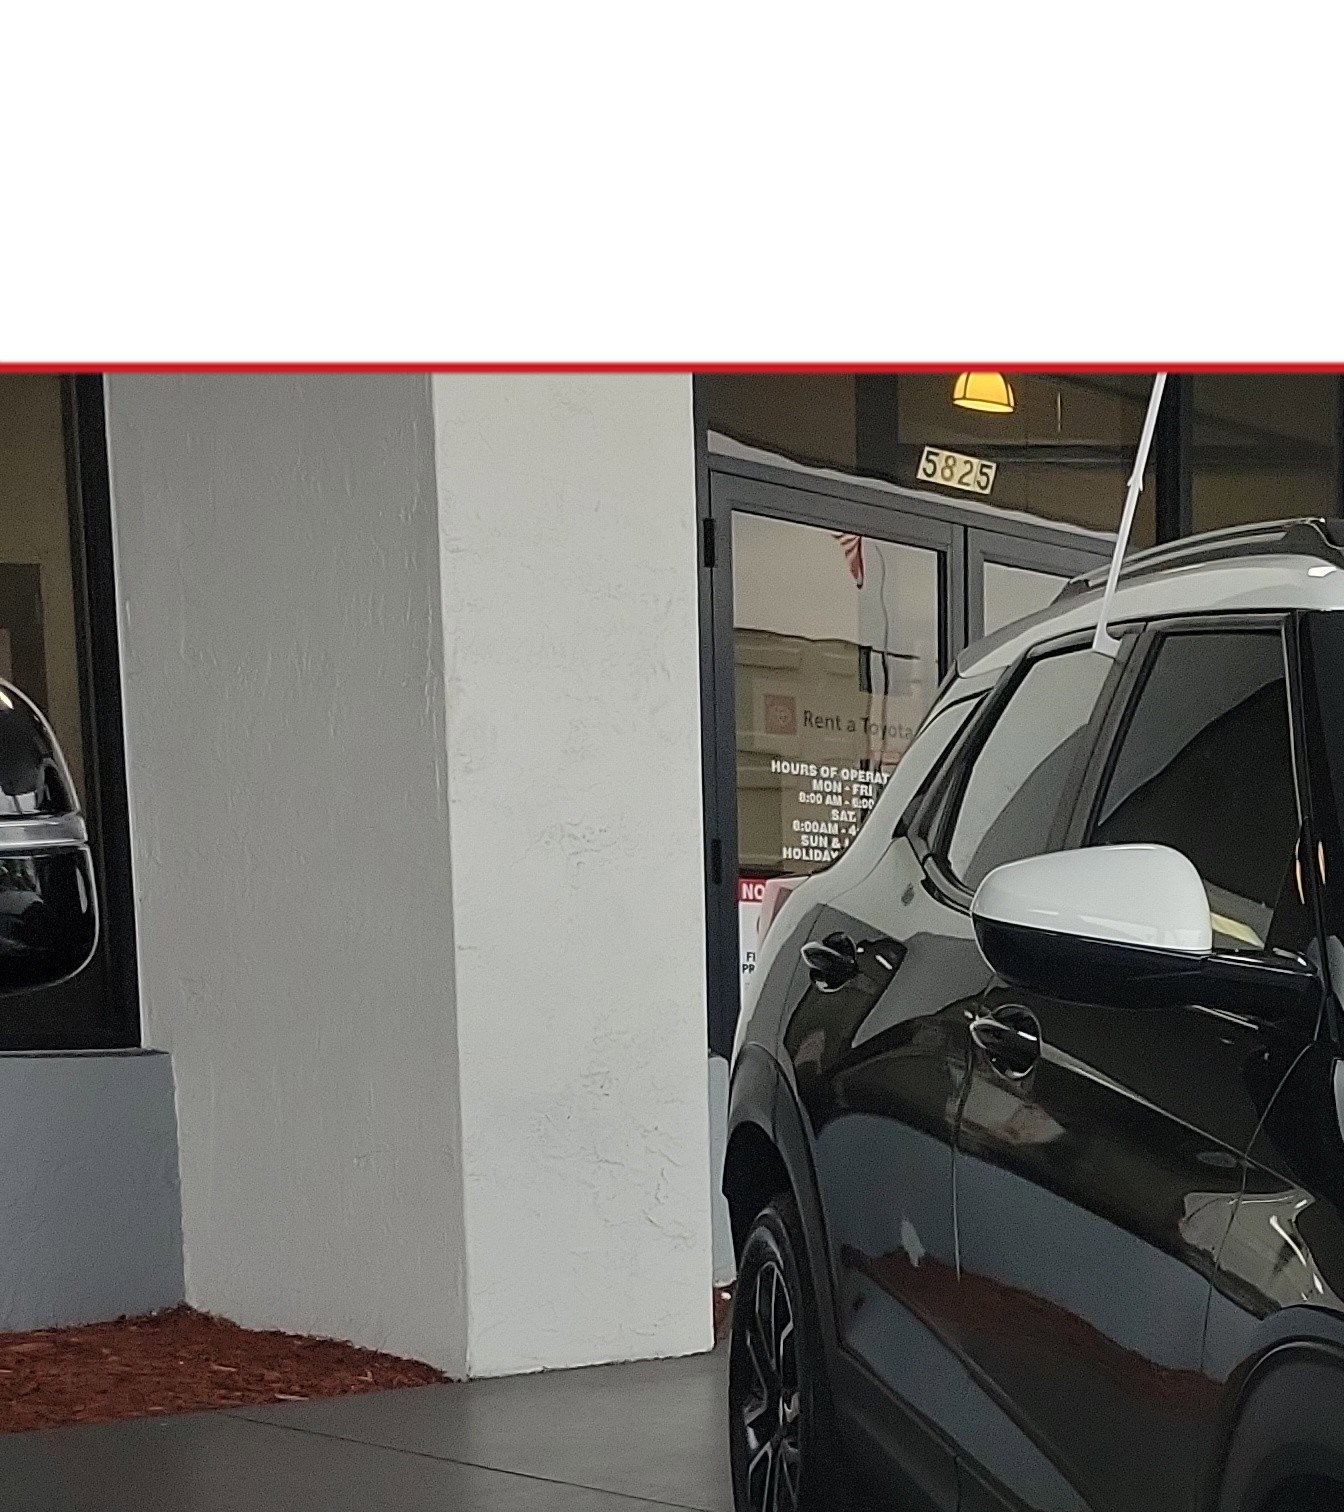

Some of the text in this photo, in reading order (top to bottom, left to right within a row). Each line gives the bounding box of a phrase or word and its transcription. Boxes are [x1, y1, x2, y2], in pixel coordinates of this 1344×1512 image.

[922, 450, 993, 491] 5825
[803, 709, 842, 731] Rent
[846, 719, 856, 733] a
[771, 759, 818, 778] HOURS
[820, 766, 839, 779] OF
[812, 779, 842, 793] MON
[852, 784, 873, 797] FRI
[825, 795, 843, 808] AM
[801, 834, 829, 848] SUN
[832, 838, 842, 849] &
